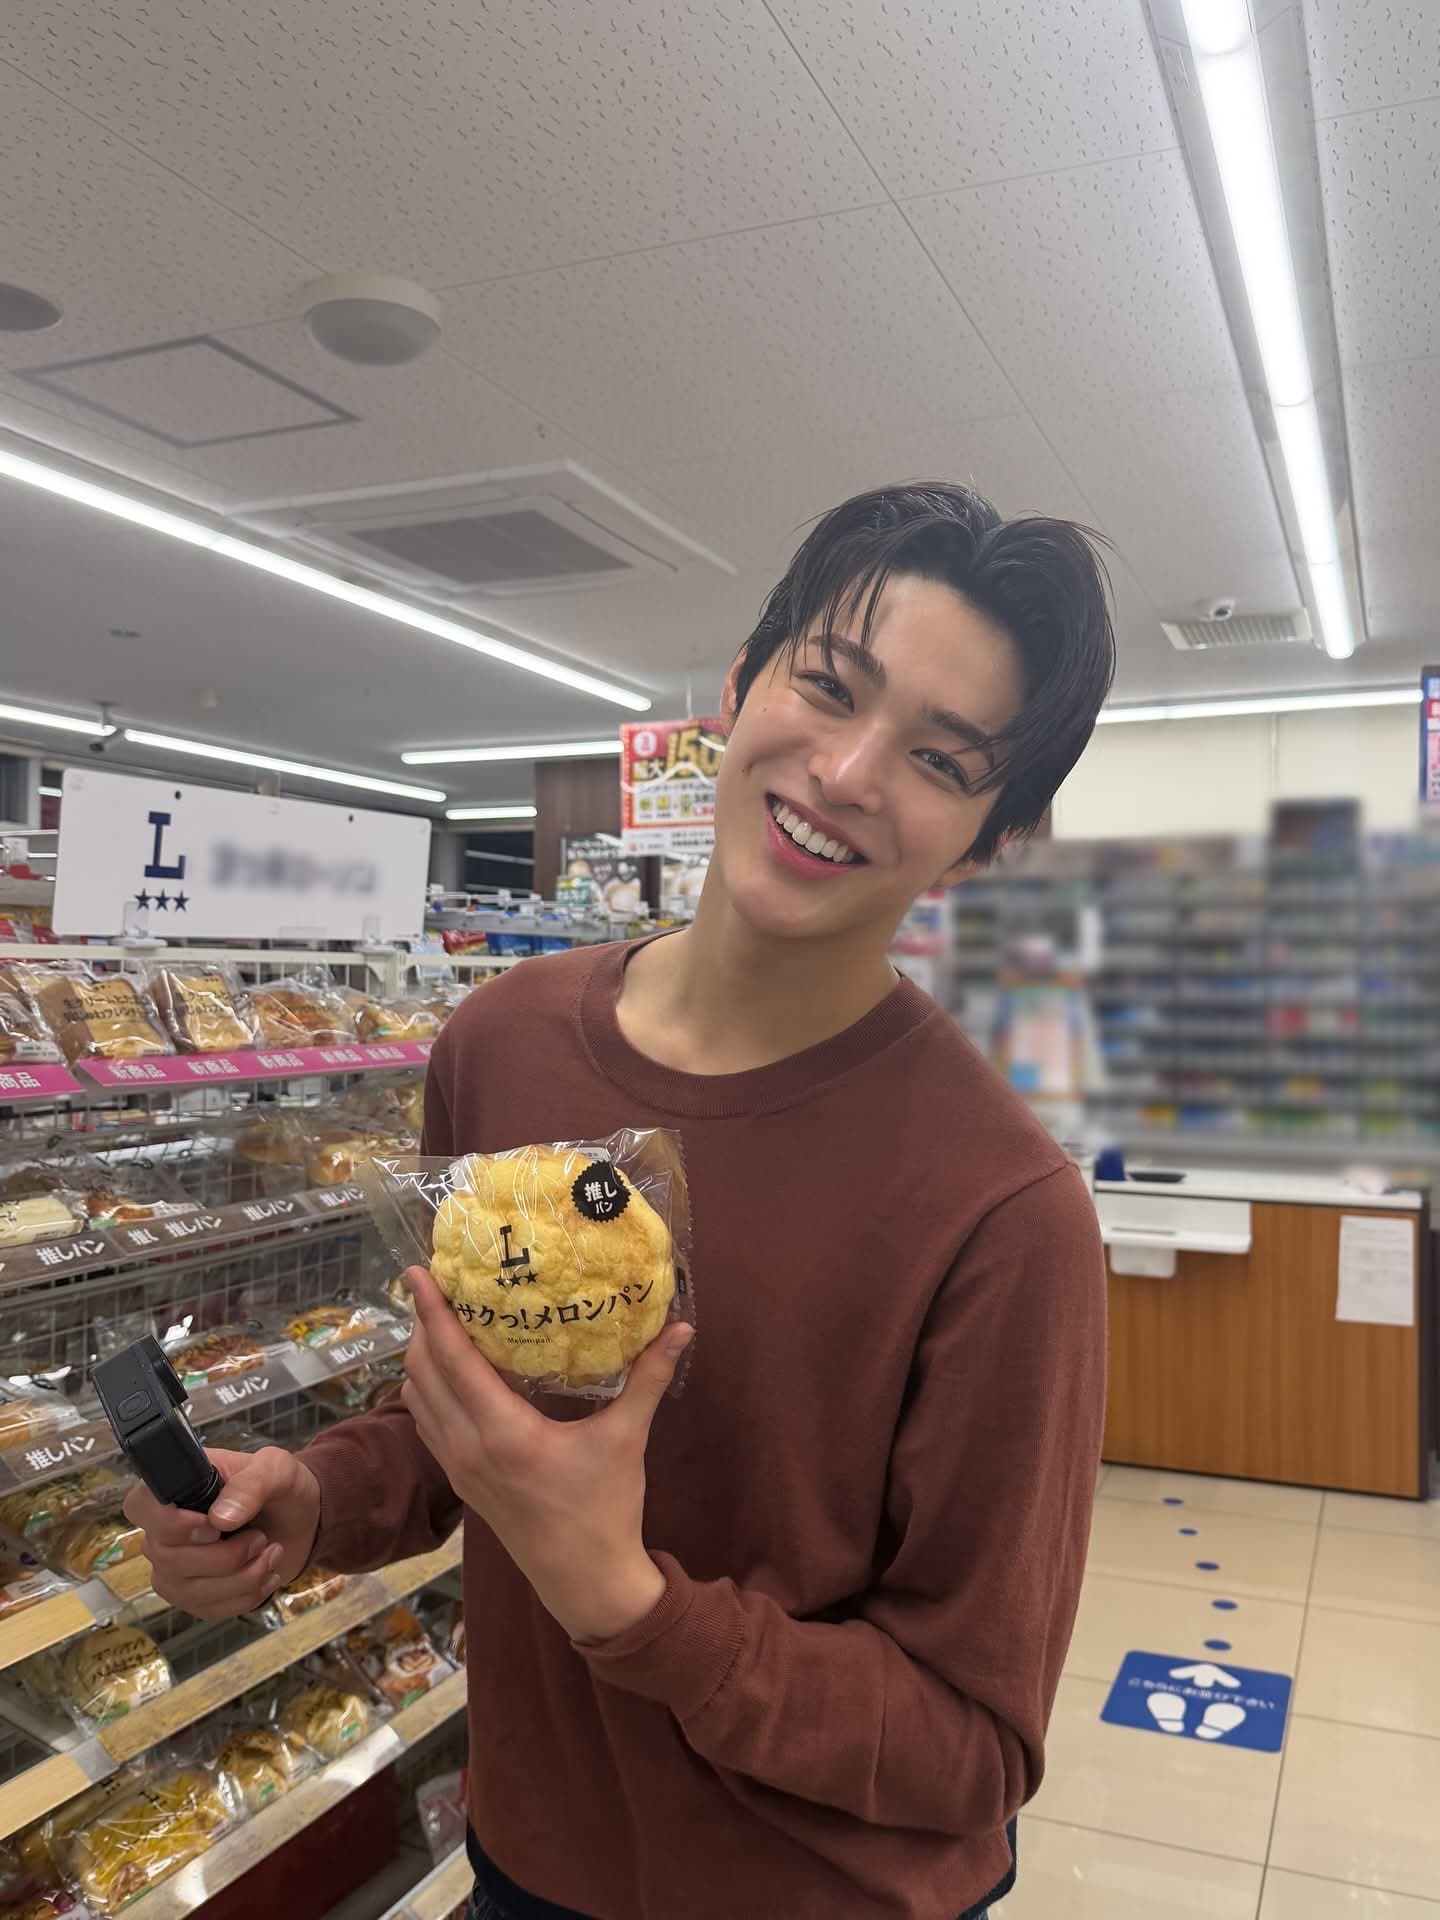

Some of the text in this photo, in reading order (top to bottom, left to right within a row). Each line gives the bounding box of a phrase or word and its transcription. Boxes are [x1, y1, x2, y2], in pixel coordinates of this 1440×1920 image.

[144, 811, 187, 880] L
[108, 1063, 167, 1080] 新商品
[187, 1058, 241, 1076] 新商品
[584, 1180, 618, 1202] 推し
[243, 1199, 295, 1222] 推しパン
[595, 1201, 613, 1215] パン
[165, 1211, 222, 1238] 推しパン
[36, 1238, 105, 1266] 推しパン
[499, 1224, 531, 1268] L
[457, 1279, 654, 1330] サクっ!メロンパン
[329, 1338, 375, 1364] 推しパン
[215, 1374, 270, 1405] 推しパン
[25, 1436, 96, 1471] 推しパン
